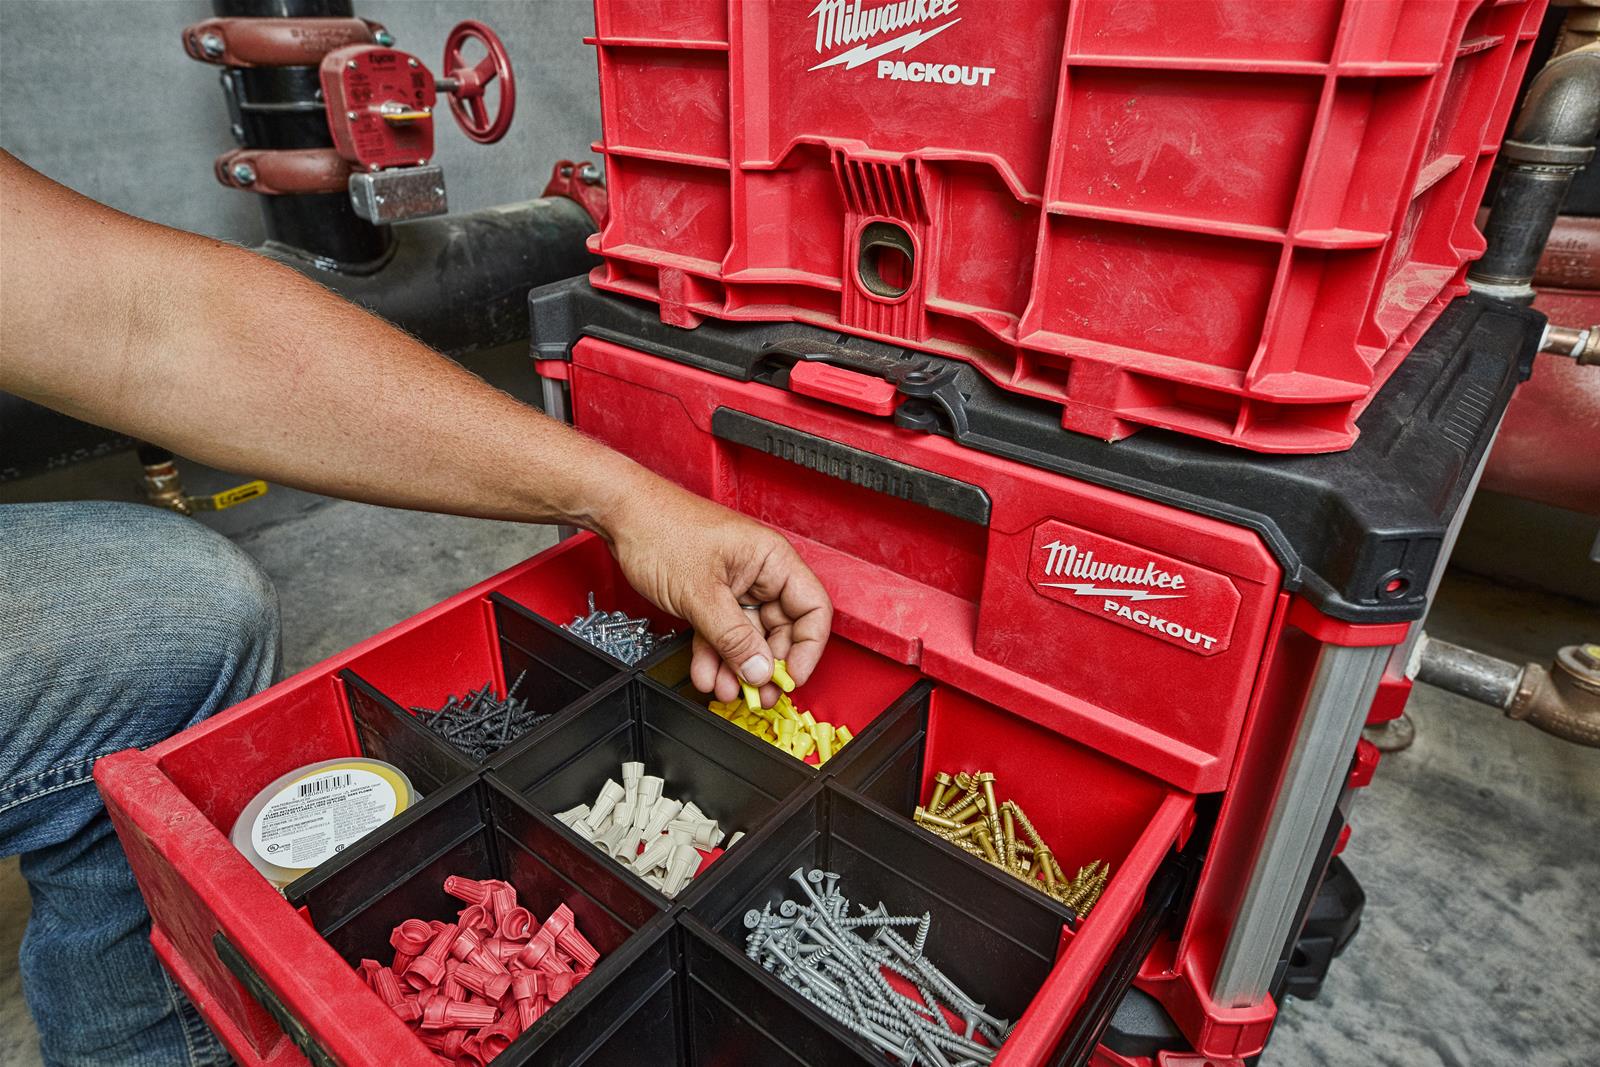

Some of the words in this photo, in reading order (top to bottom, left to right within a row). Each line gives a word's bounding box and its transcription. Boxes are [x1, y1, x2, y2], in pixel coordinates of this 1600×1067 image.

[807, 0, 959, 54] Milwaukee
[877, 60, 996, 87] PACKOUT
[1040, 540, 1186, 590] Milwaukee
[1103, 599, 1218, 650] PACKOUT
